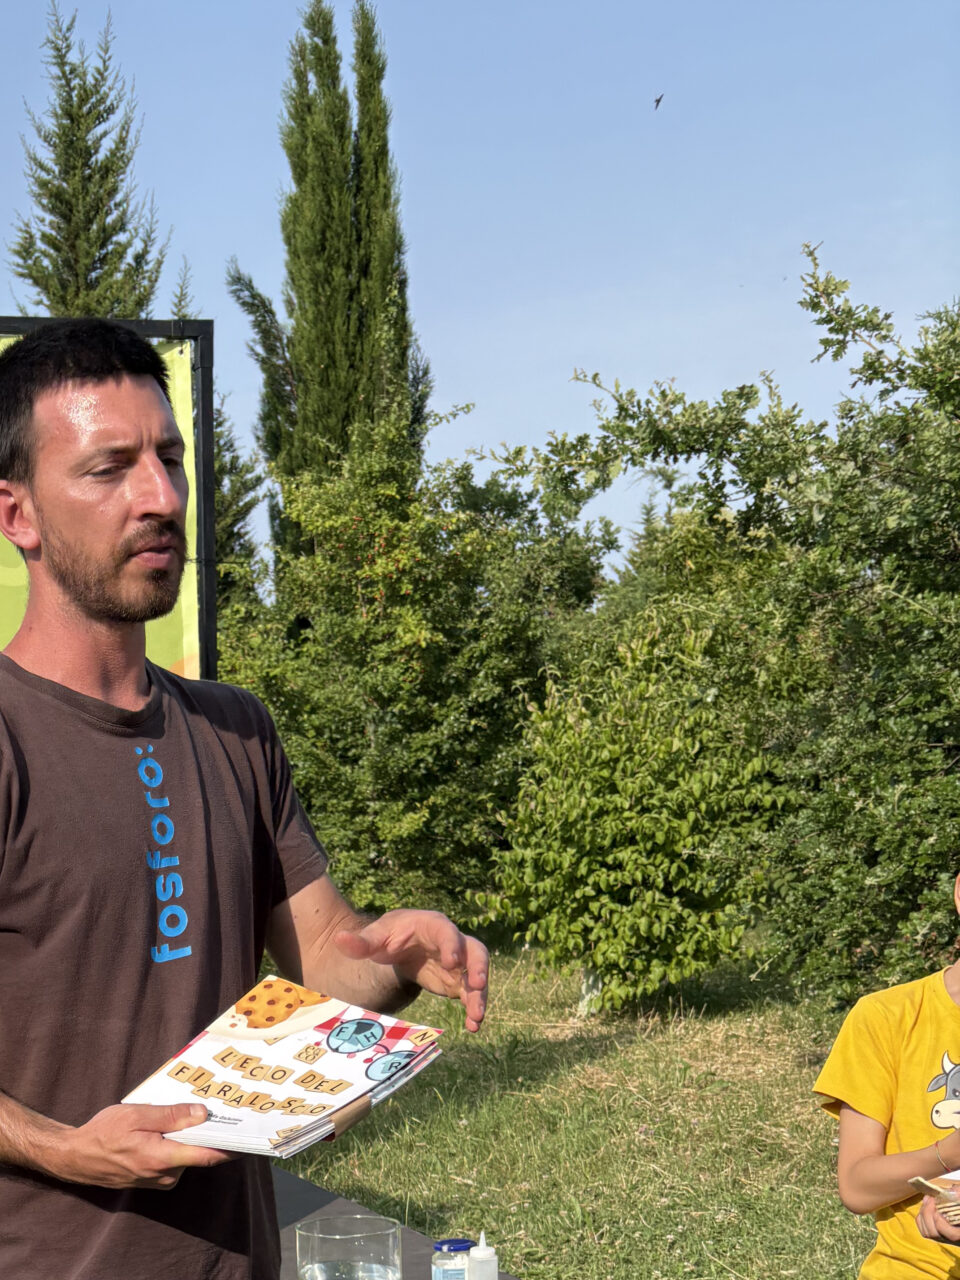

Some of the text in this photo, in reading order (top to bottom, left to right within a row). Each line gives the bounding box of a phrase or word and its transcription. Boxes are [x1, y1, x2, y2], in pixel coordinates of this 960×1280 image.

[174, 1065, 327, 1114] FIARALOSCO
[220, 1051, 344, 1091] L'ECO DEL
